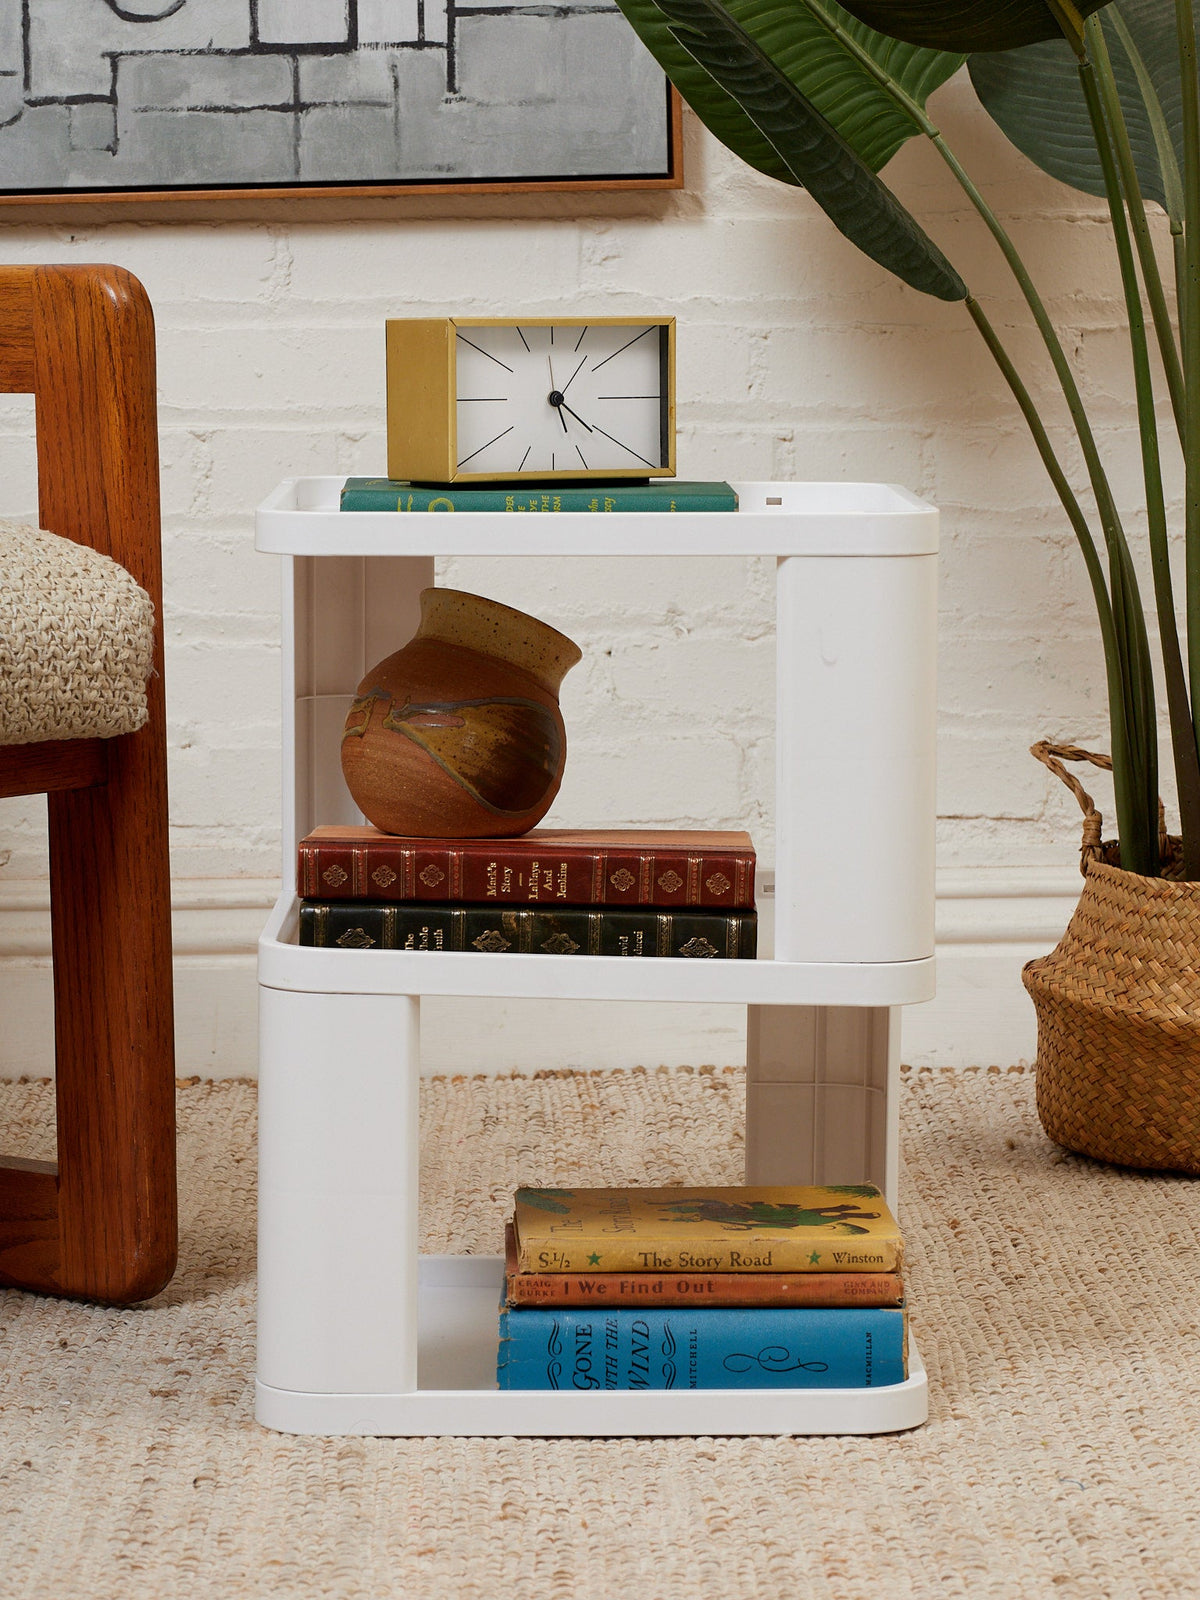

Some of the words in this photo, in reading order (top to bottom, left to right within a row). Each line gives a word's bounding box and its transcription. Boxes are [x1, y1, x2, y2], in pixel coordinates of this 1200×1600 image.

[506, 495, 514, 512] DER
[487, 862, 497, 897] Mark's
[501, 866, 513, 893] Story
[528, 861, 540, 899] LaHaye
[543, 869, 553, 891] And
[557, 862, 567, 898] Jenkins
[419, 926, 429, 951] hole
[433, 928, 443, 951] ruth
[618, 936, 629, 956] avid
[638, 1251, 672, 1268] The
[678, 1251, 723, 1271] Story
[730, 1250, 773, 1267] Road
[832, 1251, 884, 1264] Winston
[578, 1280, 608, 1294] We
[619, 1280, 663, 1294] Find
[676, 1280, 715, 1294] Out
[605, 1317, 618, 1350] THE
[572, 1323, 600, 1390] GONE
[628, 1319, 650, 1390] WIND
[689, 1328, 698, 1390] MITCHELL
